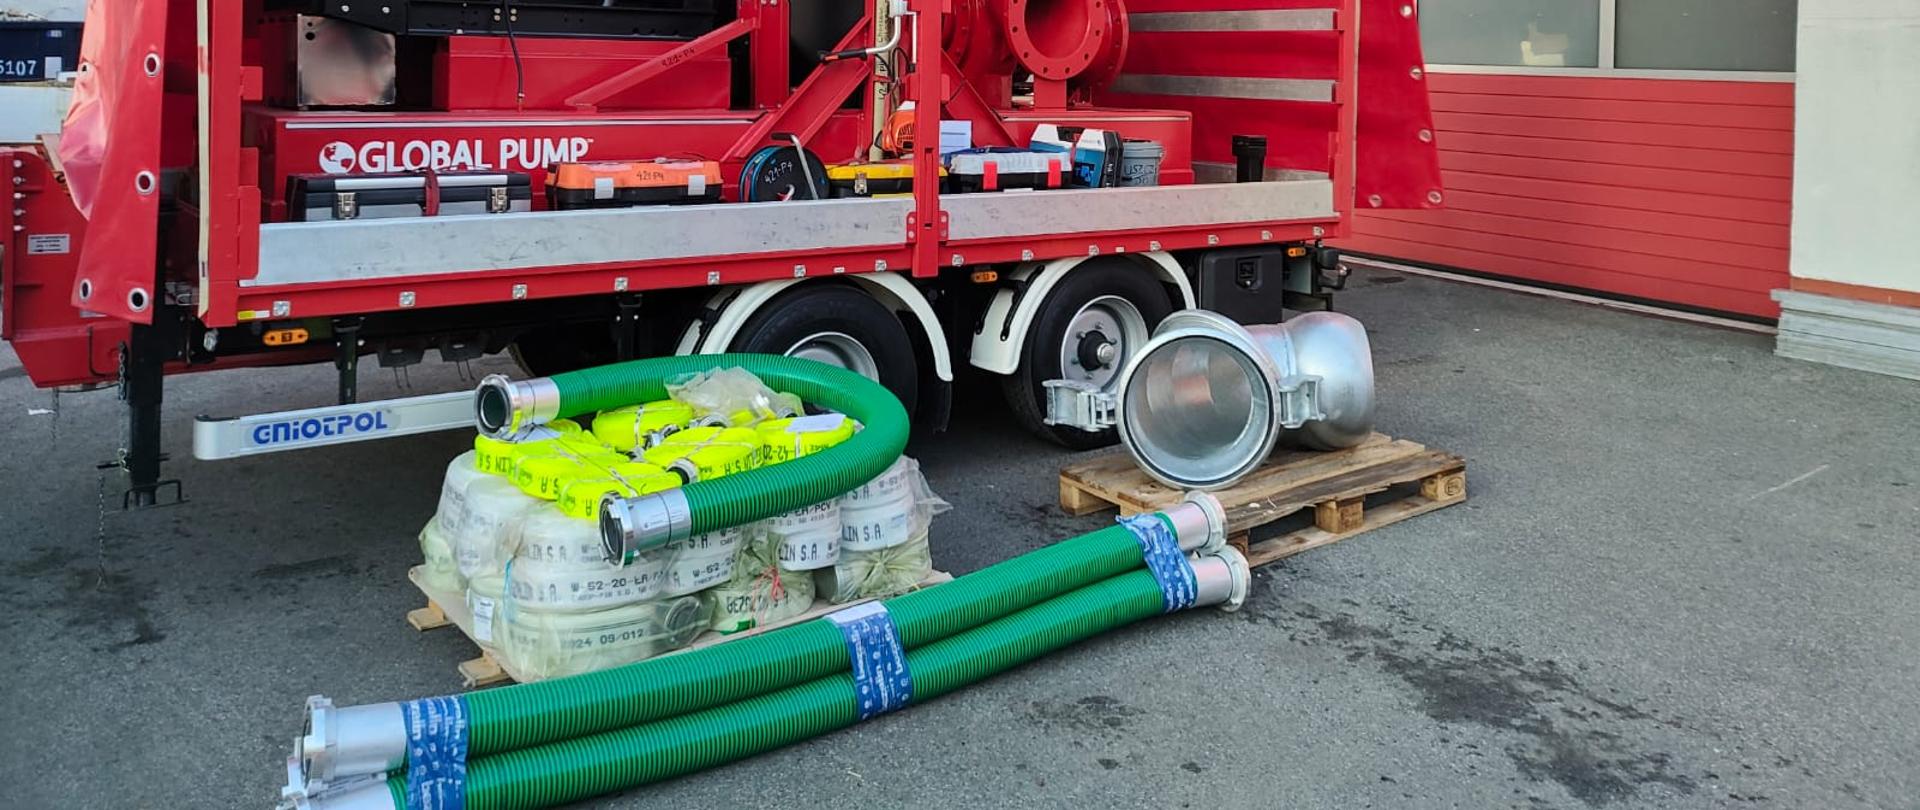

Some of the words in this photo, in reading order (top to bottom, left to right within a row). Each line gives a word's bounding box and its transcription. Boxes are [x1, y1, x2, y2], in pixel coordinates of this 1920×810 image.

[358, 139, 493, 173] GLOBAL
[500, 137, 589, 170] PUMP
[600, 628, 644, 645] 09/012
